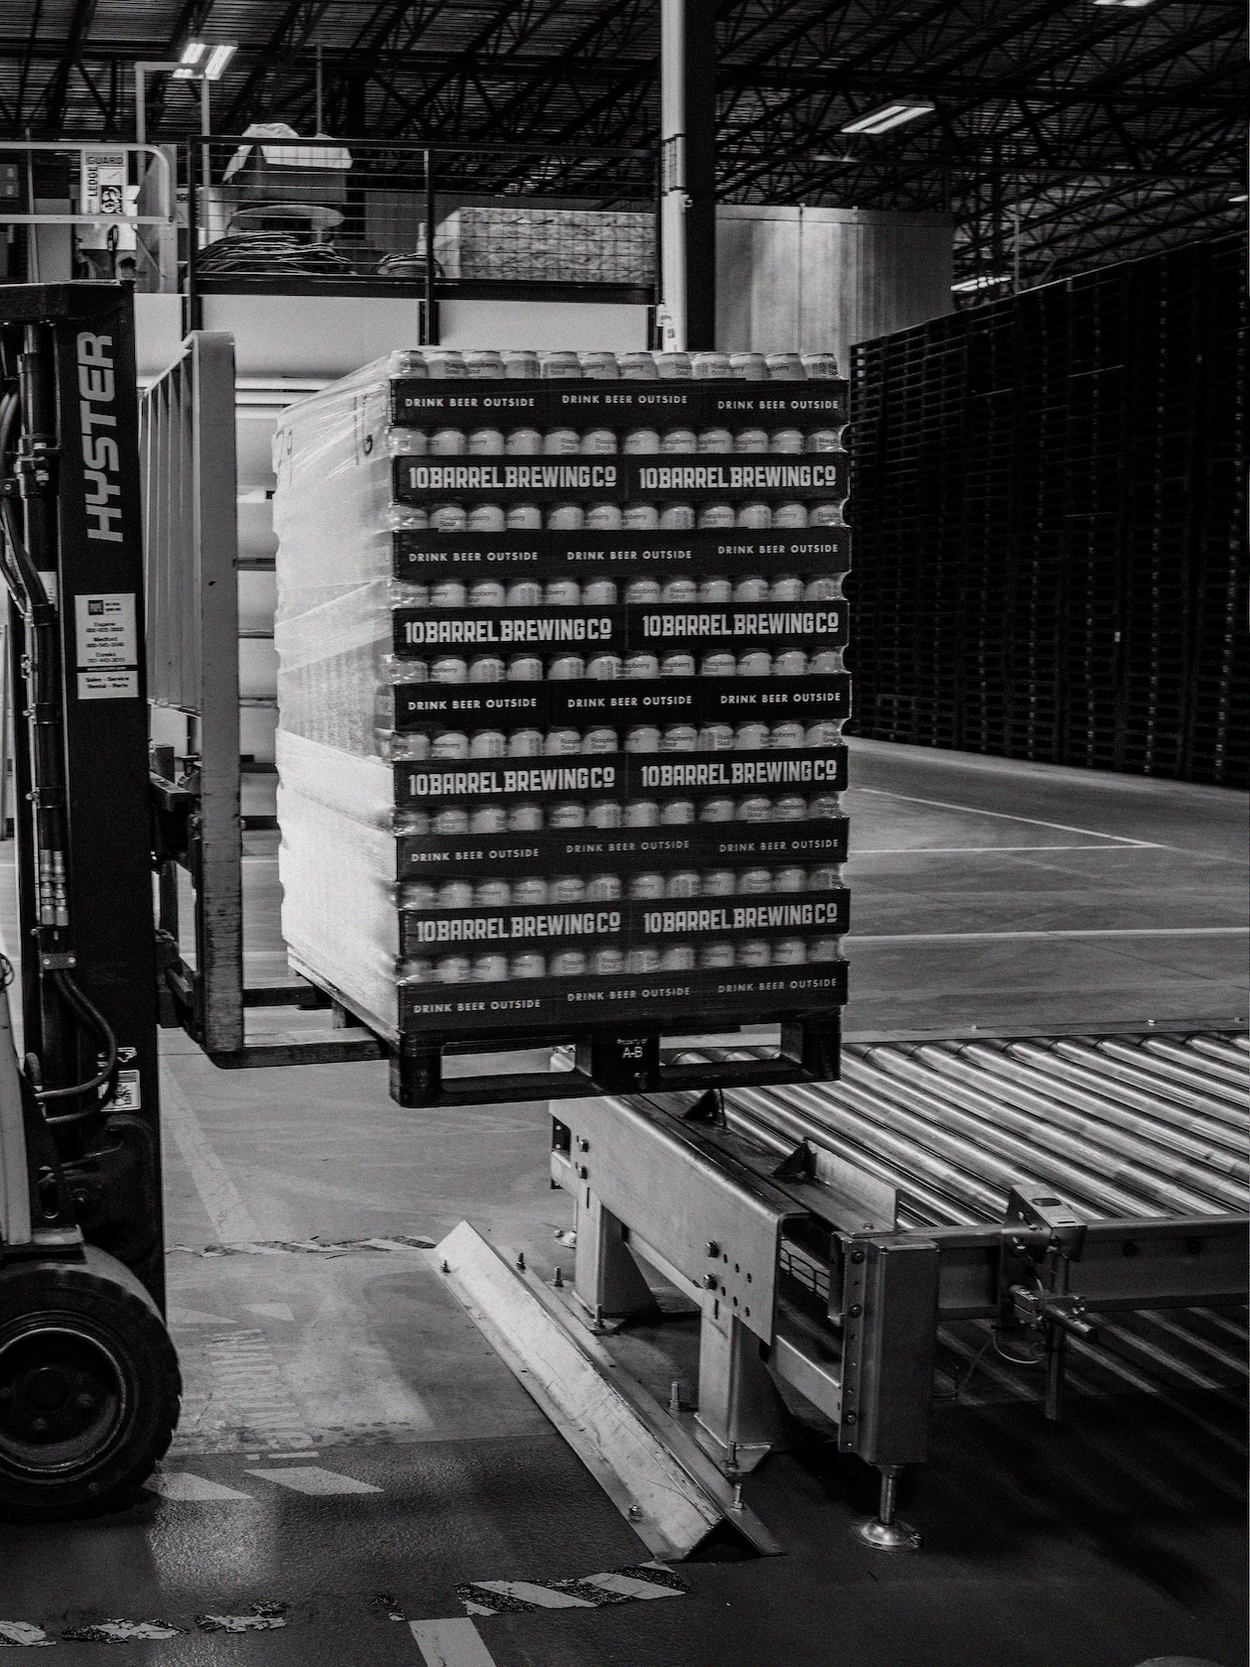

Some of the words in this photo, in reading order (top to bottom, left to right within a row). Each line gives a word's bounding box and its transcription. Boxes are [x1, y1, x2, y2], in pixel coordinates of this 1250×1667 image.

[404, 397, 444, 407] DRINK
[449, 397, 479, 407] BEER
[482, 397, 535, 407] OUTSIDE
[561, 394, 600, 404] DRINK
[605, 394, 633, 404] BEER
[637, 394, 688, 404] OUTSIDE
[717, 400, 754, 410] DRINK
[759, 400, 786, 410] BEER
[790, 400, 839, 411] OUTSIDE
[77, 331, 123, 543] HYSTER
[566, 551, 605, 561] DRINK
[609, 550, 638, 560] BEER
[642, 550, 692, 560] OUTSIDE
[717, 545, 754, 555] DRINK
[759, 544, 786, 554] BEER
[790, 543, 838, 554] OUTSIDE
[408, 552, 448, 562] DRINK
[453, 552, 482, 562] BEER
[486, 551, 538, 562] OUTSIDE
[408, 700, 447, 711] DRINK
[452, 699, 481, 710] BEER
[485, 698, 537, 708] OUTSIDE
[567, 698, 606, 708] DRINK
[610, 697, 638, 707] BEER
[642, 695, 692, 706] OUTSIDE
[720, 694, 757, 704] DRINK
[761, 693, 788, 703] BEER
[792, 692, 841, 703] OUTSIDE
[566, 843, 604, 854] DRINK
[608, 842, 636, 852] BEER
[640, 840, 690, 851] OUTSIDE
[719, 842, 755, 853] DRINK
[760, 841, 787, 851] BEER
[791, 838, 839, 850] OUTSIDE
[410, 852, 450, 863] DRINK
[455, 850, 484, 861] BEER
[488, 848, 539, 859] OUTSIDE
[717, 983, 754, 994] DRINK
[758, 981, 785, 991] BEER
[789, 978, 837, 989] OUTSIDE
[567, 991, 605, 1002] DRINK
[608, 989, 637, 1000] BEER
[641, 986, 690, 998] OUTSIDE
[413, 1003, 453, 1014] DRINK
[457, 1001, 486, 1012] BEER
[490, 998, 541, 1010] OUTSIDE
[622, 1046, 643, 1059] A-B
